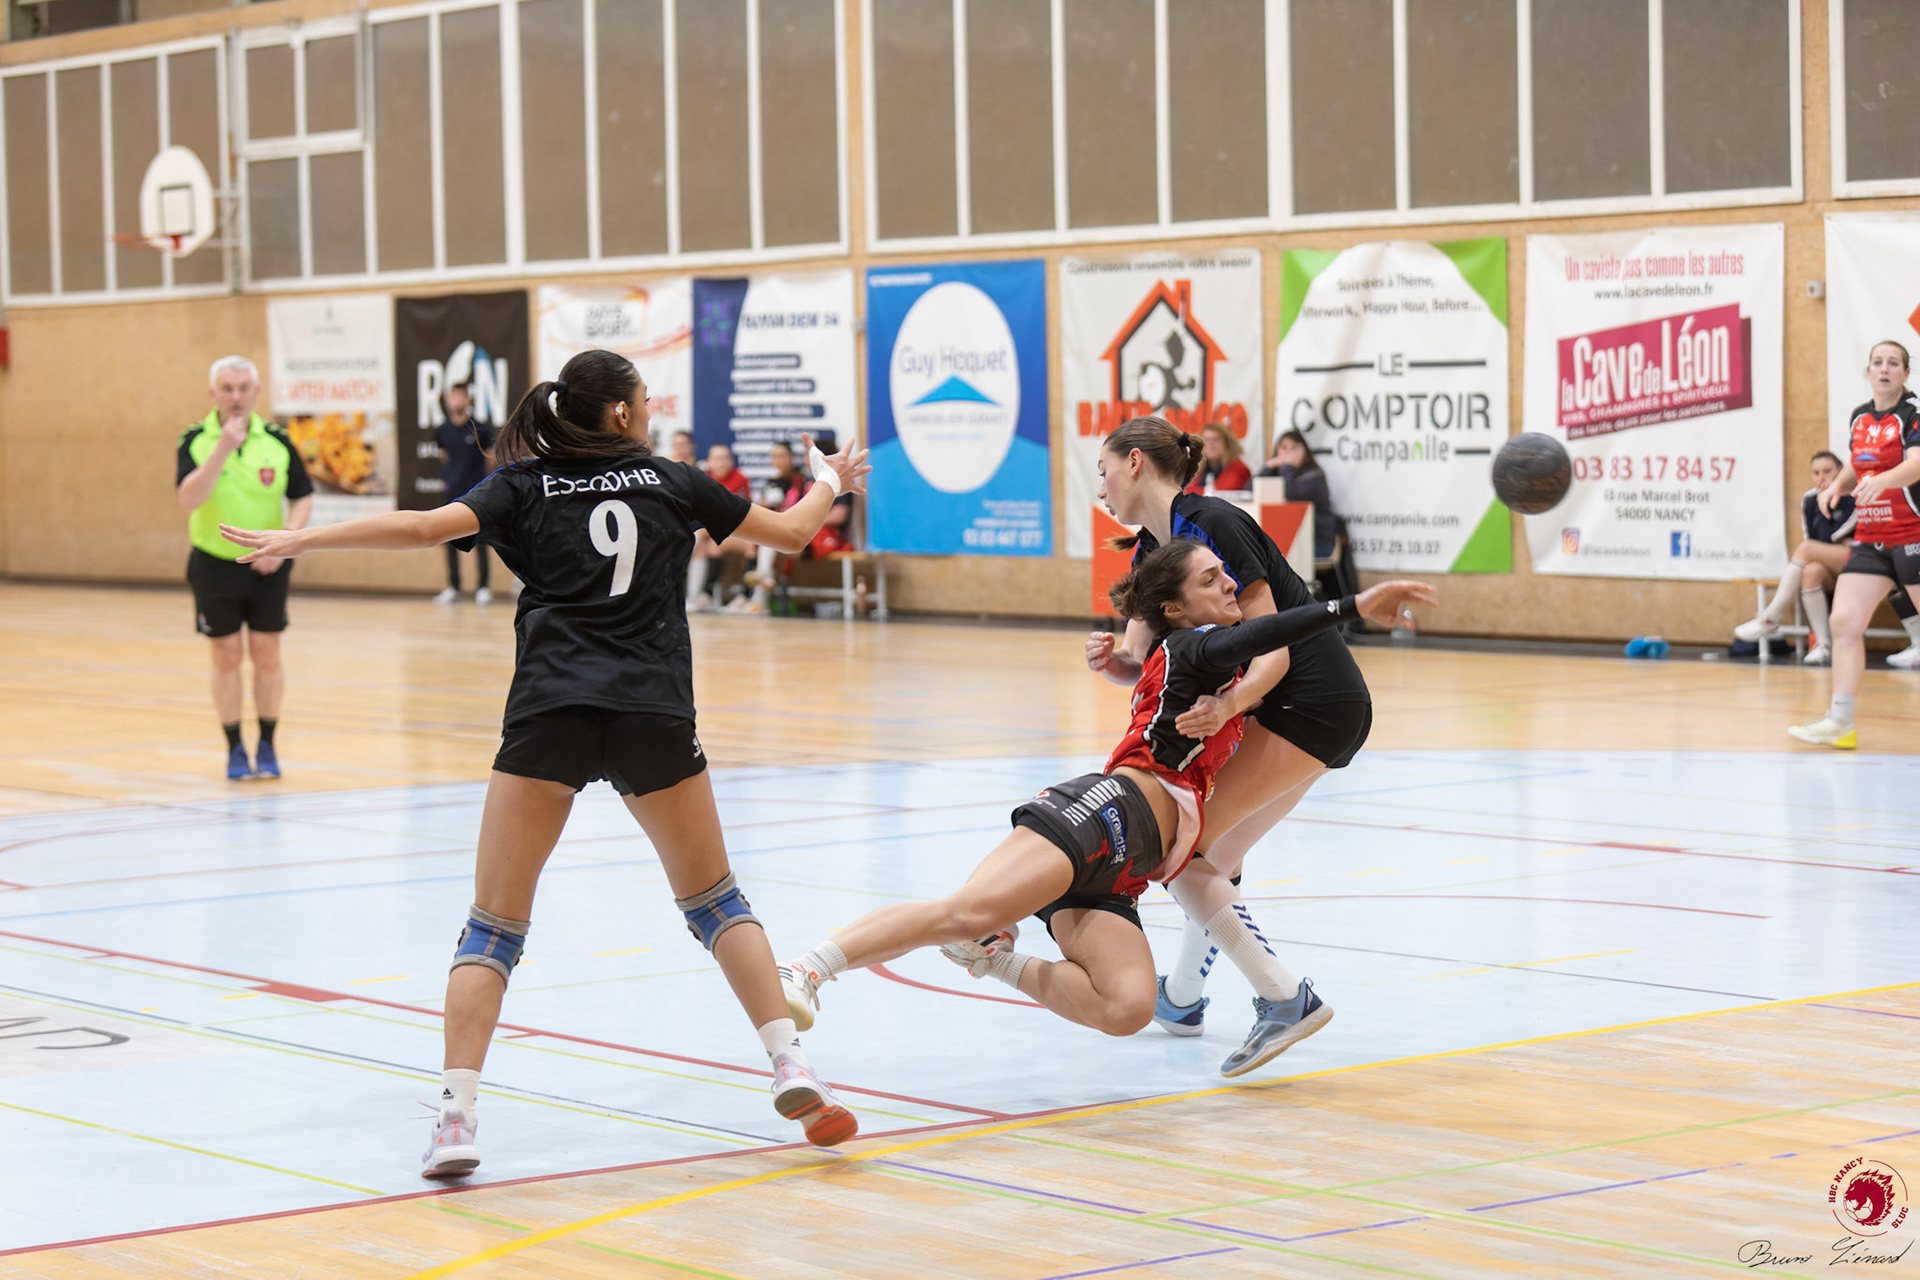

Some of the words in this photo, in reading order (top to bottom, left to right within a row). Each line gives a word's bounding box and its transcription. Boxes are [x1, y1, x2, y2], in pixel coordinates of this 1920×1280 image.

[1565, 256, 1580, 282] Un
[1646, 253, 1685, 278] comme
[1689, 250, 1704, 276] les
[1708, 249, 1744, 276] autres
[1594, 282, 1714, 299] www.lacavedeleon.fr
[899, 346, 934, 378] Guy
[1378, 354, 1404, 377] LE
[1562, 377, 1574, 411] la
[1574, 337, 1645, 409] Cave
[1644, 360, 1661, 396] de
[1662, 315, 1730, 392] Léon
[1292, 393, 1491, 433] COMPTOIR
[1337, 436, 1450, 469] Campanile
[1573, 456, 1604, 481] 03
[1610, 456, 1632, 481] 83
[1642, 456, 1668, 481] 17
[1676, 457, 1704, 482] 84
[1709, 457, 1736, 482] 57
[1618, 490, 1637, 502] rue
[1641, 488, 1681, 503] Marcel
[1685, 489, 1710, 503] Brot
[1615, 507, 1651, 521] 54000
[1654, 507, 1695, 521] NANCY
[589, 499, 638, 597] 9
